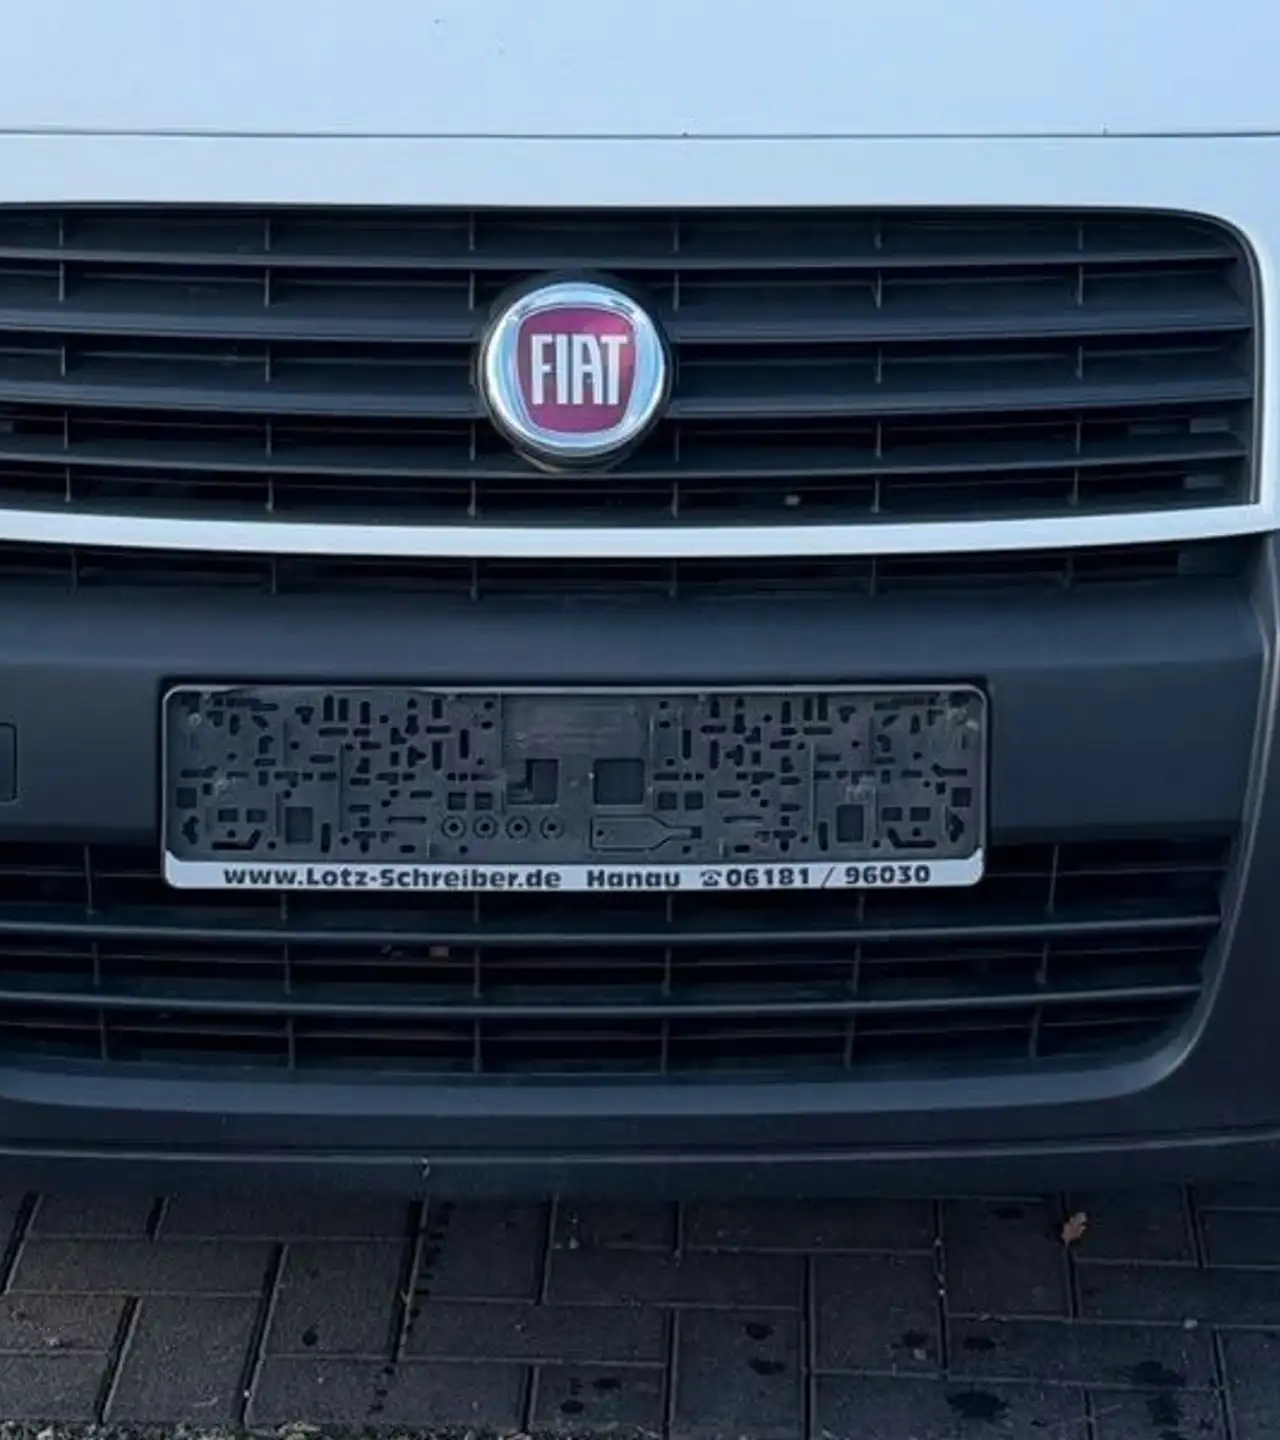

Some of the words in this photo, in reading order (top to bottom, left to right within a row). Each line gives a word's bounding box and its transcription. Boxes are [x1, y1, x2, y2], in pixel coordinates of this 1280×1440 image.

[531, 334, 628, 405] FIAT
[223, 867, 562, 888] www.Lotz-Schreiber.de
[586, 868, 681, 888] Hanau
[844, 864, 932, 885] 96030
